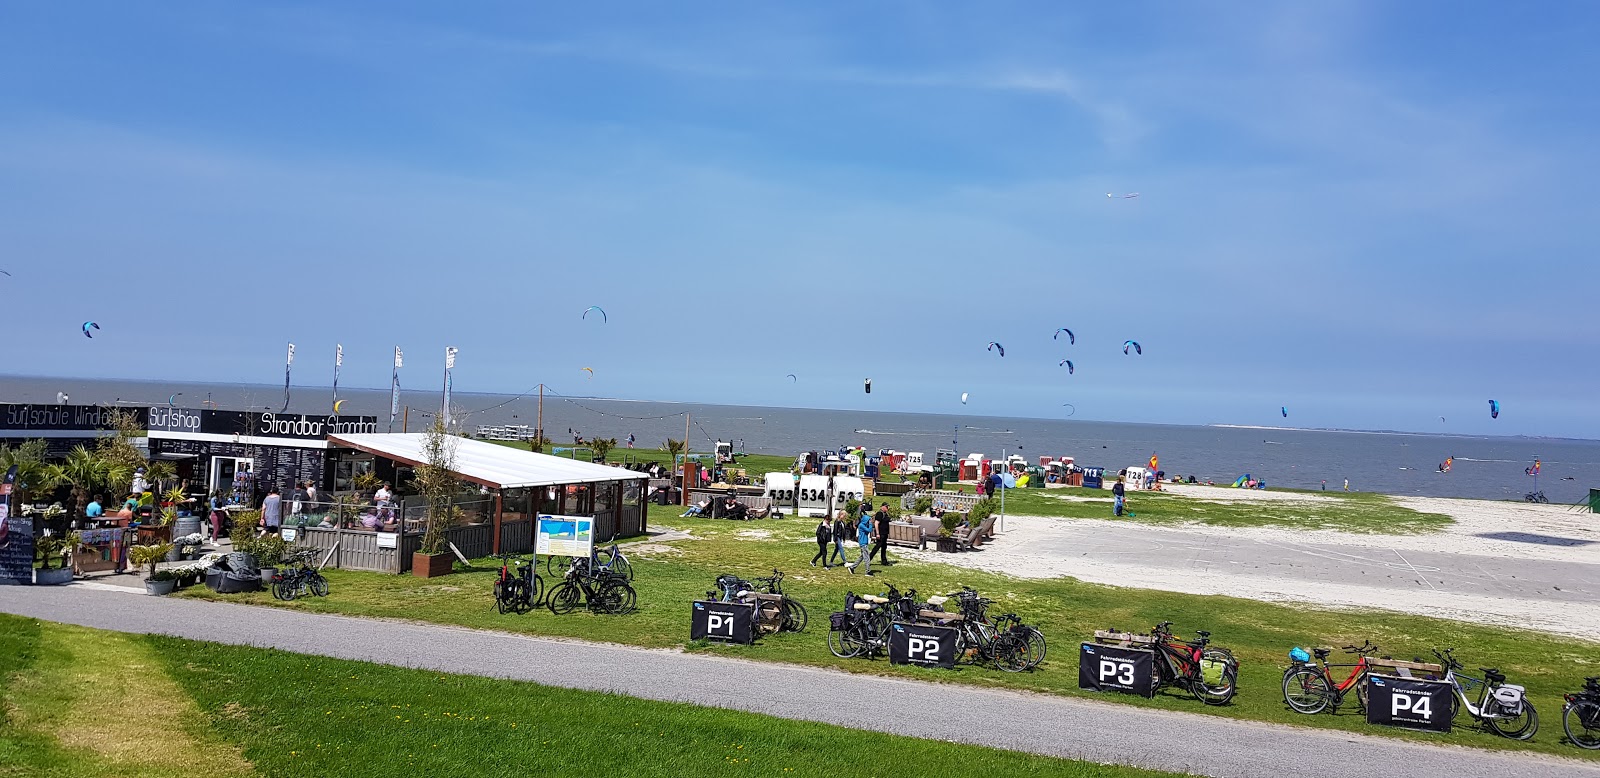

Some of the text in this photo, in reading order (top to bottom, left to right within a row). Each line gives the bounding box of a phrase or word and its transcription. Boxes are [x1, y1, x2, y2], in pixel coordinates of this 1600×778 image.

[7, 404, 70, 428] Surfschule
[149, 406, 201, 433] Surfshop
[260, 412, 325, 436] Strandbar
[908, 455, 921, 463] 725
[1084, 468, 1097, 478] 713
[1127, 471, 1142, 480] 728
[769, 489, 794, 501] 533
[801, 488, 826, 503] 534
[708, 615, 734, 635] P1
[909, 638, 939, 660] P2
[1100, 661, 1134, 685] P3
[1392, 693, 1432, 719] P4
